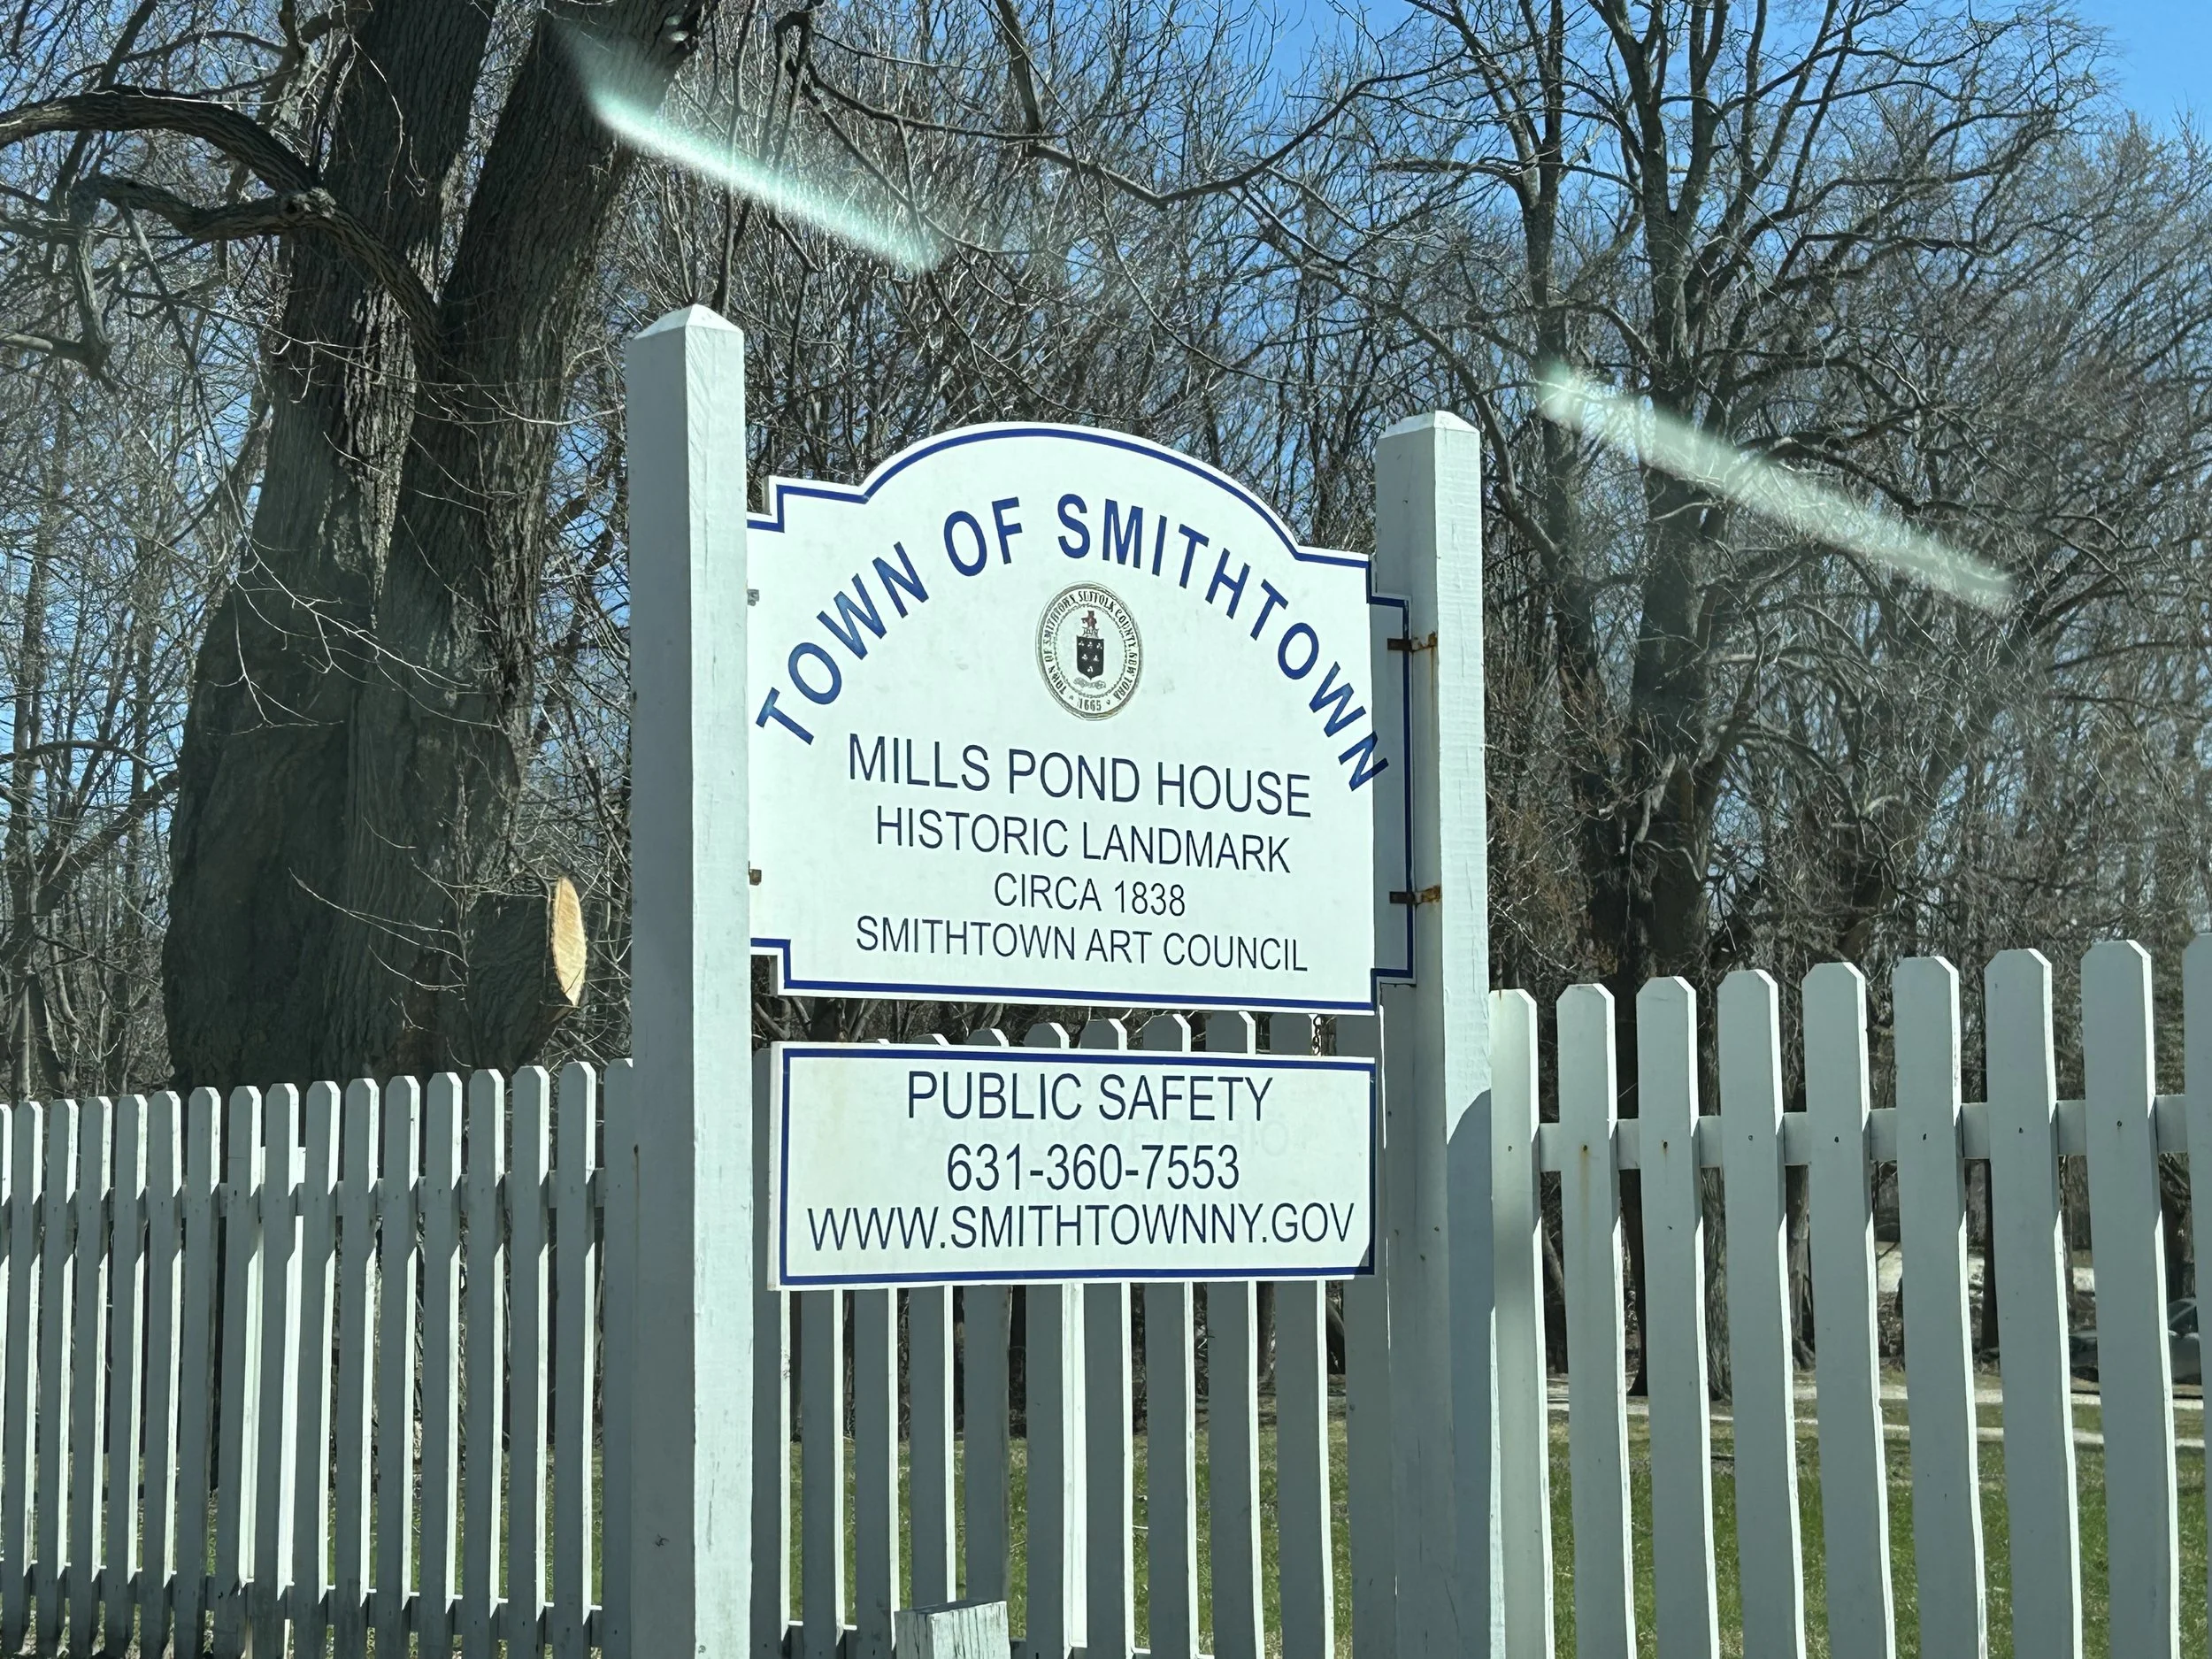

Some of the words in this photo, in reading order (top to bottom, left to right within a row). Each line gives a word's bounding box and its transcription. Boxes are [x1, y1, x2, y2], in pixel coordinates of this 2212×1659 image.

[756, 541, 929, 745] TOWN
[944, 497, 1022, 576] OF
[1057, 494, 1388, 791] SMITHTOWN
[849, 733, 989, 791] MILLS
[1010, 749, 1140, 803] POND
[1158, 762, 1310, 818] HOUSE
[878, 806, 1068, 857] HISTORIC
[1084, 822, 1290, 873] LANDMARK
[995, 872, 1102, 911] CIRCA
[1114, 879, 1185, 917] 1838
[857, 916, 1074, 960] SMITHTOWN
[1086, 929, 1152, 964] ART
[1164, 933, 1308, 972] COUNCIL
[909, 1071, 1081, 1120] PUBLIC
[1099, 1074, 1272, 1121] SAFETY
[948, 1144, 1239, 1191] 631-360-7553
[808, 1202, 1354, 1251] WWW.SMITHTOWNNY.GOV
